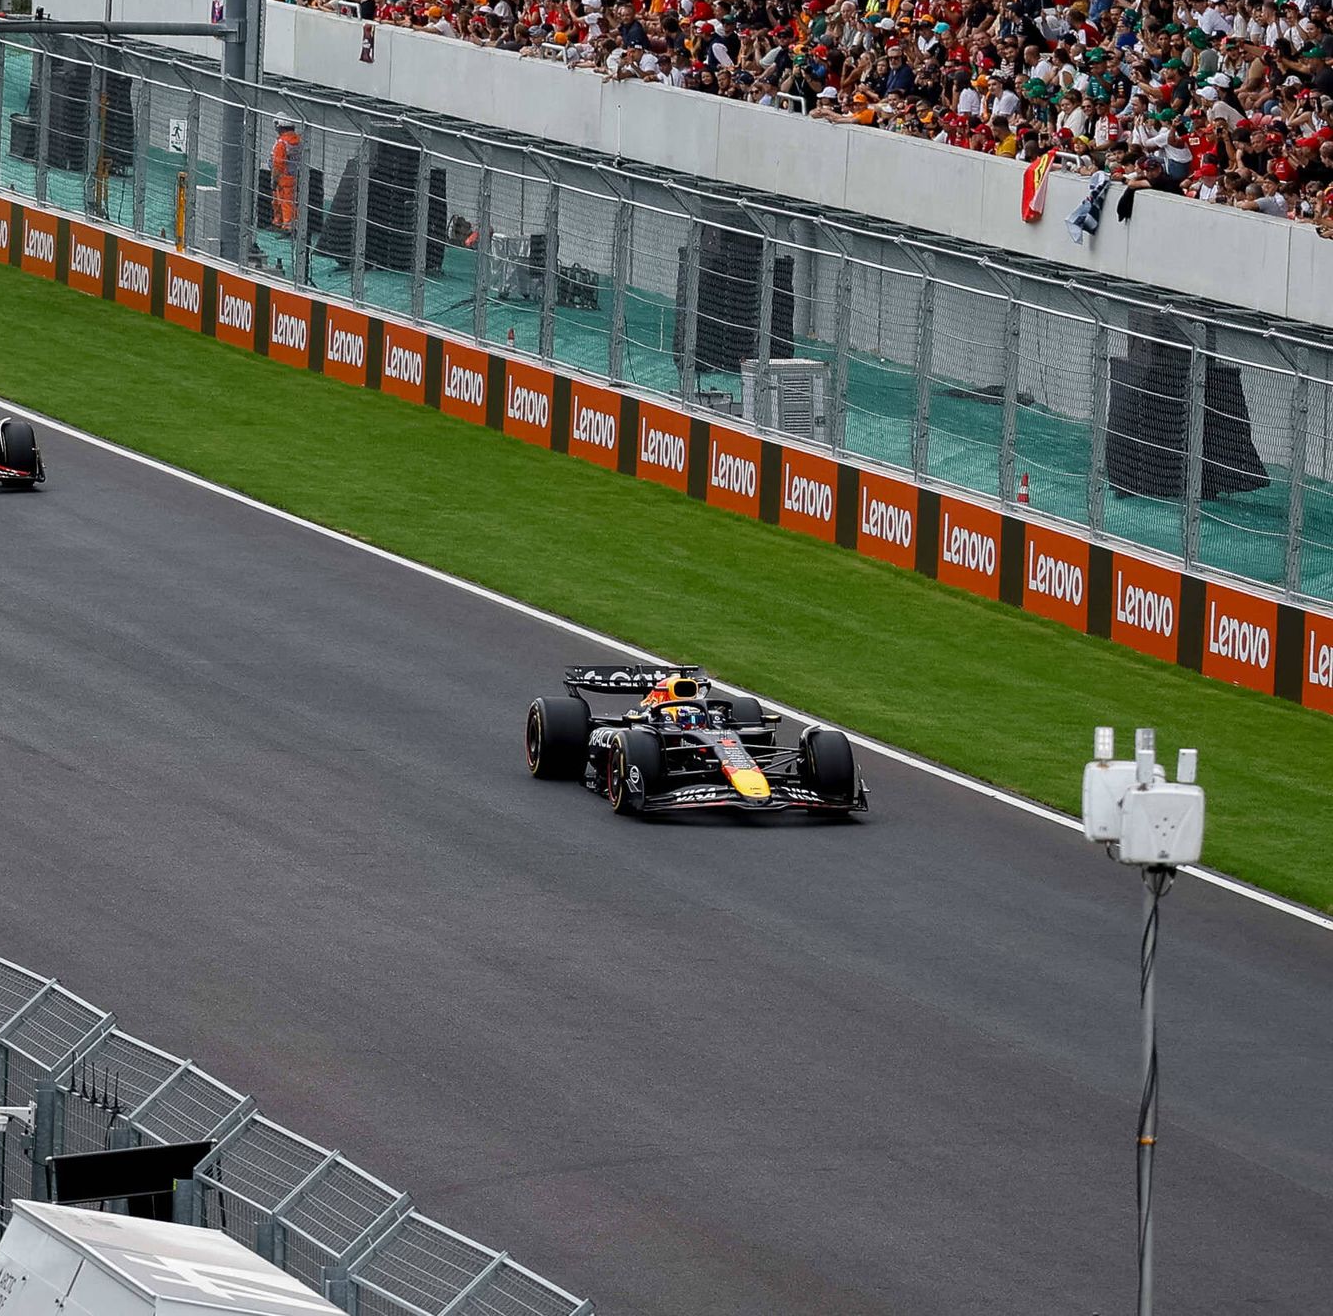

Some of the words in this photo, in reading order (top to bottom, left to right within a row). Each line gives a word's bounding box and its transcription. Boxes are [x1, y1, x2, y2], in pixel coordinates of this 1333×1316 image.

[24, 219, 54, 263] Lenovo
[70, 233, 102, 279] Lenovo
[118, 250, 150, 296] Lenovo
[166, 265, 200, 314] Lenovo
[218, 284, 252, 333] Lenovo
[271, 303, 307, 351] Lenovo
[327, 318, 364, 368] Lenovo
[384, 335, 423, 386] Lenovo
[444, 354, 484, 406] Lenovo
[507, 374, 549, 428] Lenovo
[573, 395, 616, 450] Lenovo
[640, 416, 685, 473] Lenovo
[711, 440, 756, 498] Lenovo
[784, 462, 832, 522] Lenovo
[861, 486, 912, 548] Lenovo
[943, 512, 996, 576] Lenovo
[1028, 540, 1083, 606] Lenovo
[1116, 570, 1173, 637] Lenovo
[1209, 601, 1270, 669] Lenovo
